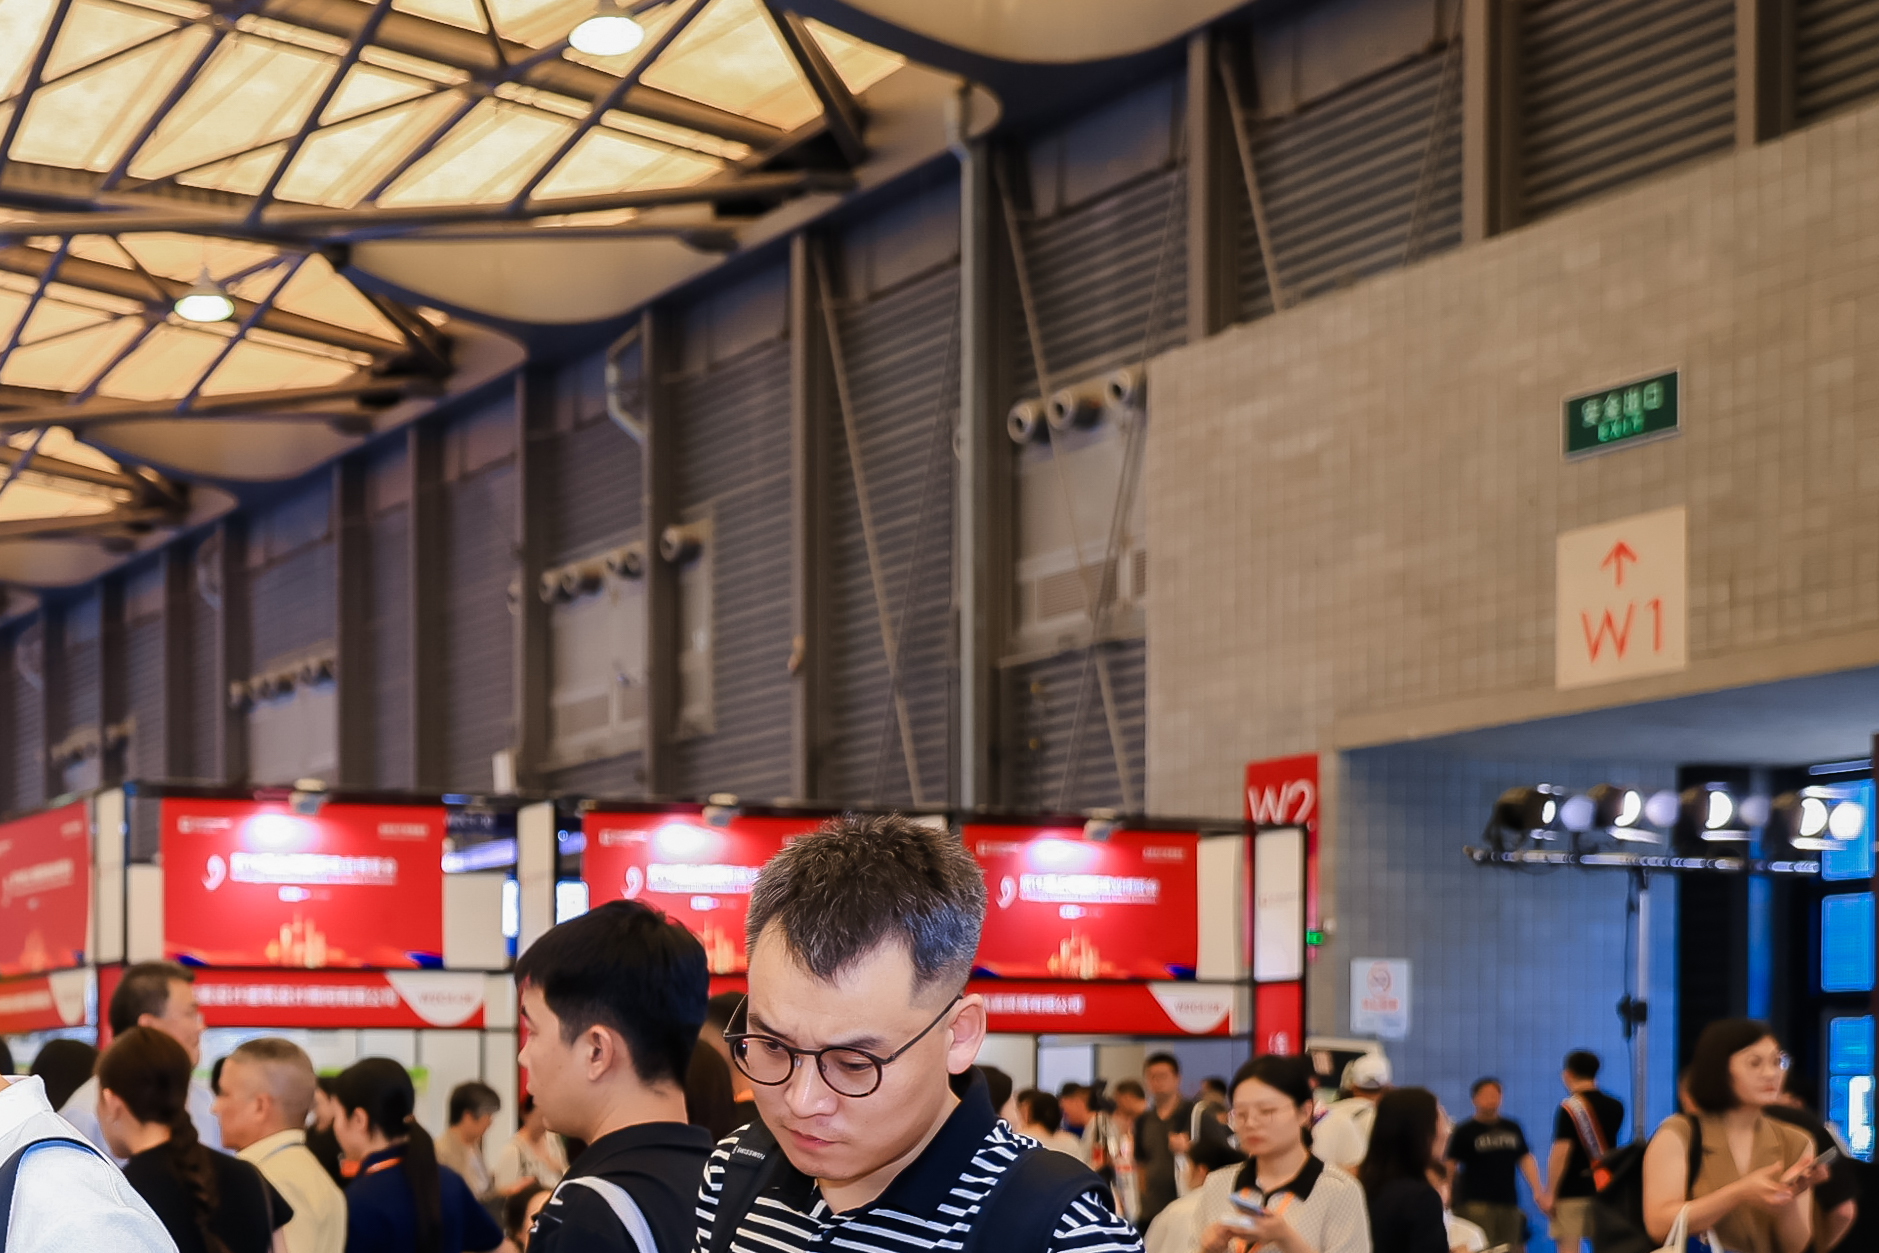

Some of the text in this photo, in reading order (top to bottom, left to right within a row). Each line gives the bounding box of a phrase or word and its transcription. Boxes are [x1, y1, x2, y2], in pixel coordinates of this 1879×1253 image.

[1581, 381, 1664, 428] 安全出口
[1598, 415, 1644, 442] EXIT
[1581, 598, 1663, 664] W1
[1248, 778, 1316, 824] W2
